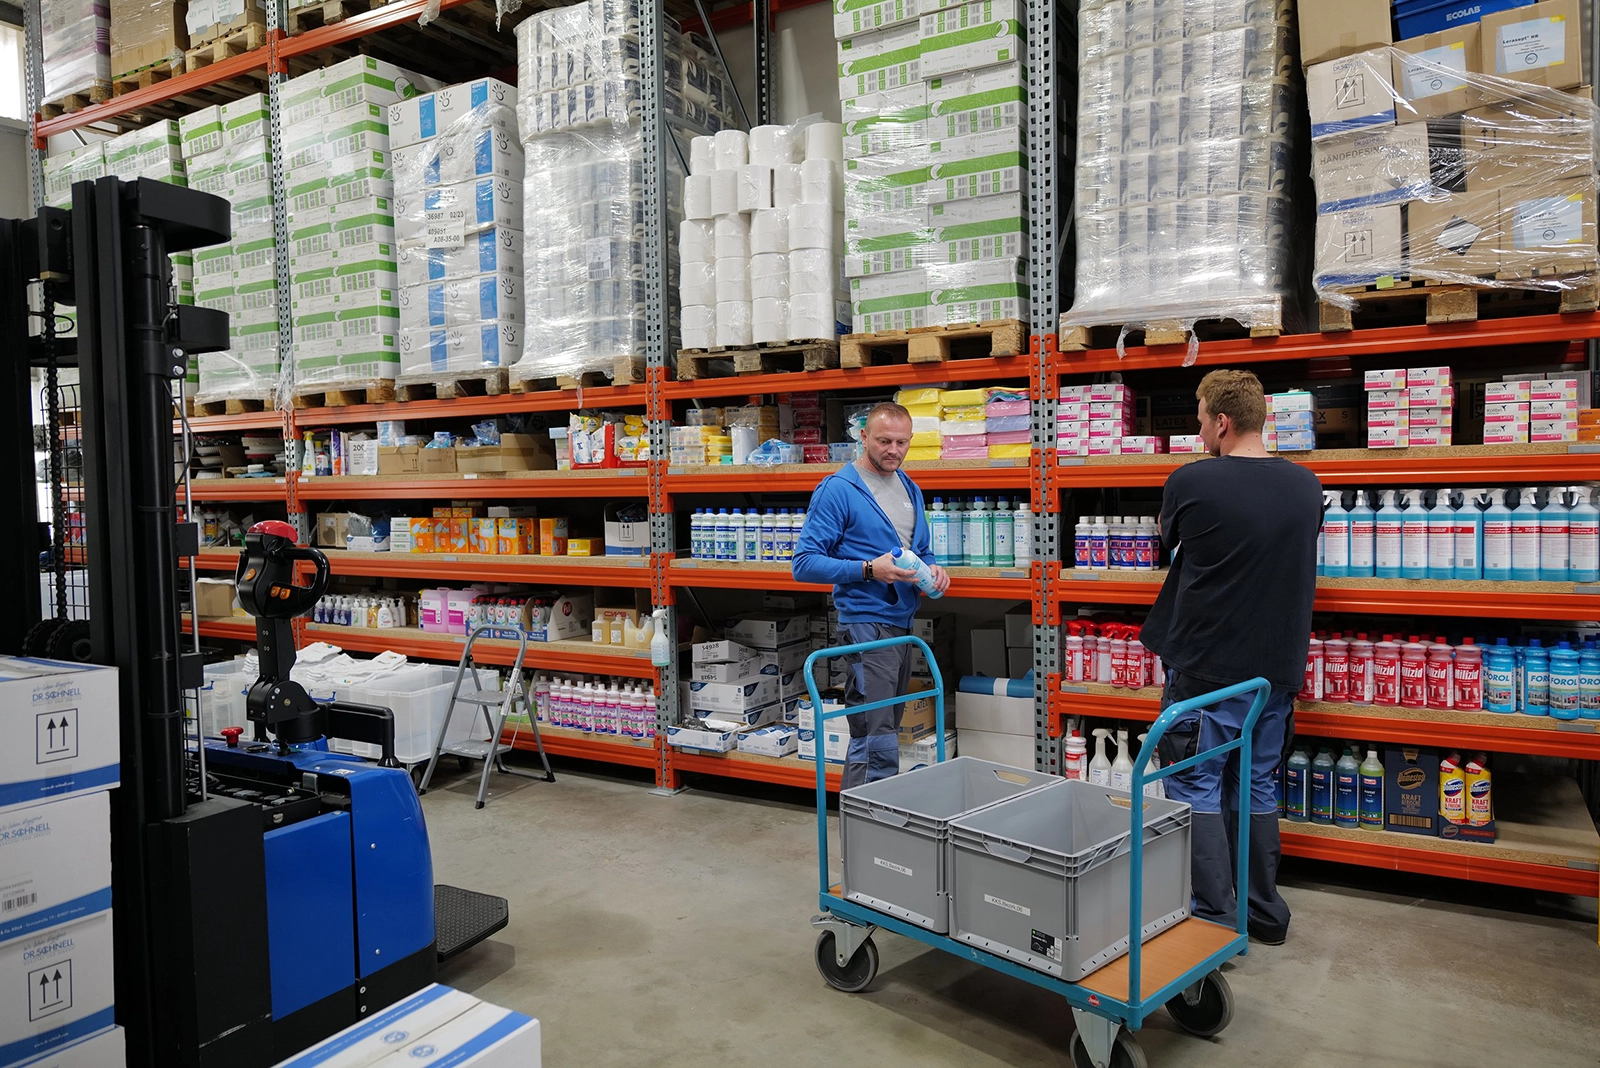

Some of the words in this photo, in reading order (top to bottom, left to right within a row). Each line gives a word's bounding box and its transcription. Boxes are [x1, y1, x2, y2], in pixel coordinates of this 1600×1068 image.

[1445, 5, 1481, 22] ECOLAB
[427, 212, 444, 220] 36987
[450, 210, 464, 218] 02/23
[433, 235, 460, 243] A08-35-00
[1155, 417, 1187, 427] LATEX
[603, 610, 627, 618] CWS
[701, 643, 720, 651] 54928
[1325, 663, 1348, 672] Milizid
[1455, 669, 1479, 680] Milizid
[1488, 674, 1510, 682] OROL
[1550, 677, 1577, 686] FOROL
[1580, 678, 1600, 686] ORO
[32, 687, 81, 702] DR.SCHNELL
[914, 700, 928, 712] LATEX
[1401, 793, 1421, 801] KRAFT
[880, 861, 906, 873] KKS.Bezirk.06
[991, 897, 1024, 913] KKS.Bezirk.06
[23, 938, 74, 961] DR.SCHNELL
